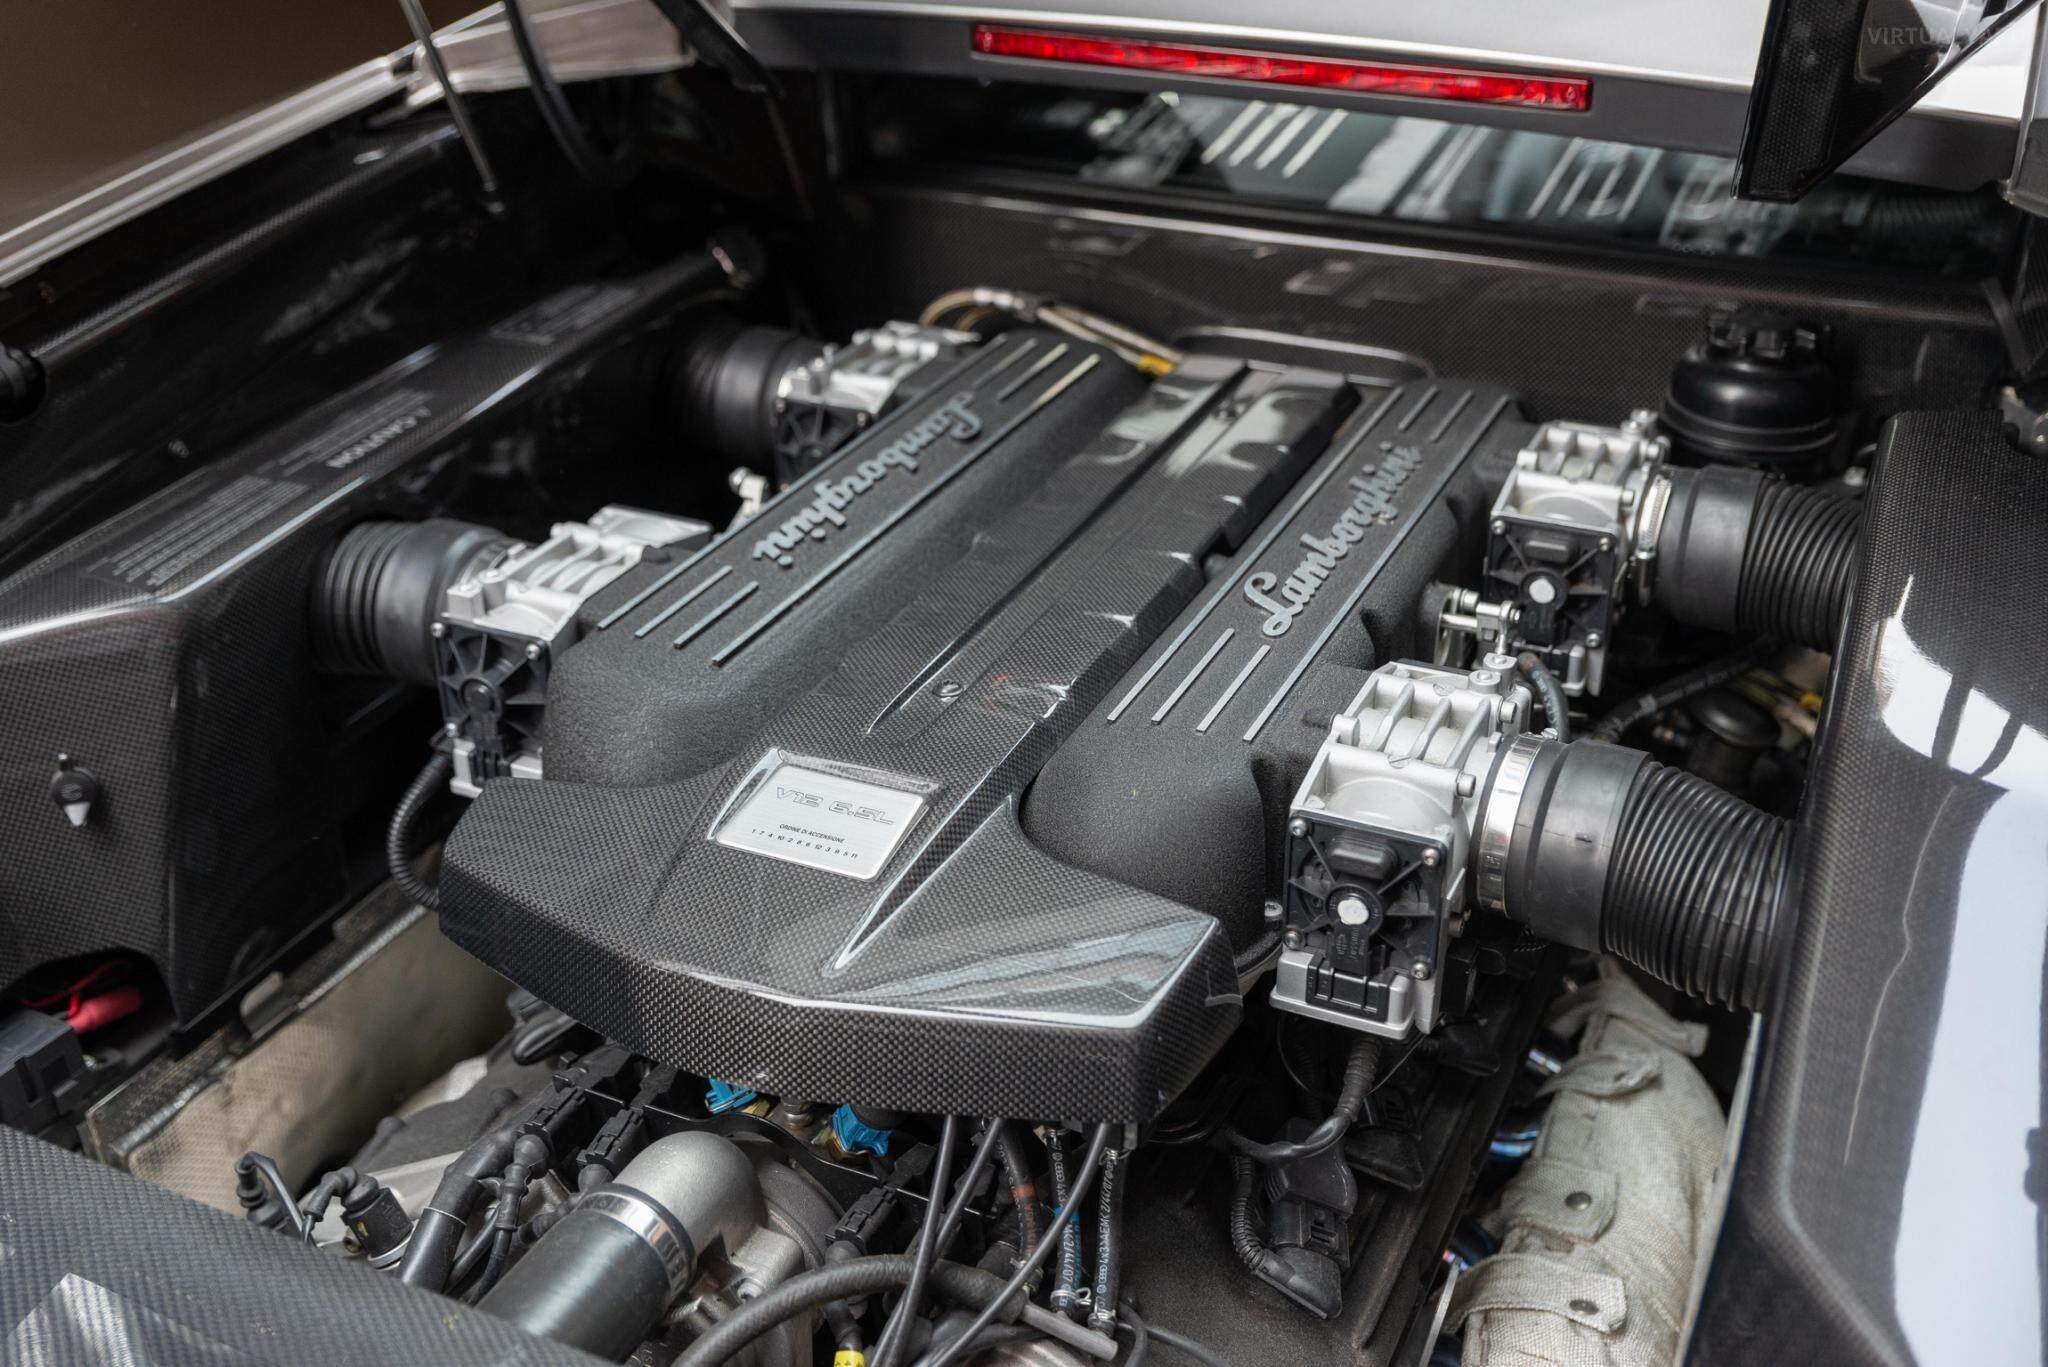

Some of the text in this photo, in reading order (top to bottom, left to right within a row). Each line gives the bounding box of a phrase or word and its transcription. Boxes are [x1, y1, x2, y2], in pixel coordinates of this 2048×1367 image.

[752, 391, 982, 568] Lamborghini
[1243, 440, 1422, 637] Lamborghini
[776, 786, 894, 825] V12 6.5L
[779, 823, 801, 833] ORDINE
[808, 831, 845, 843] ACCENSIONE
